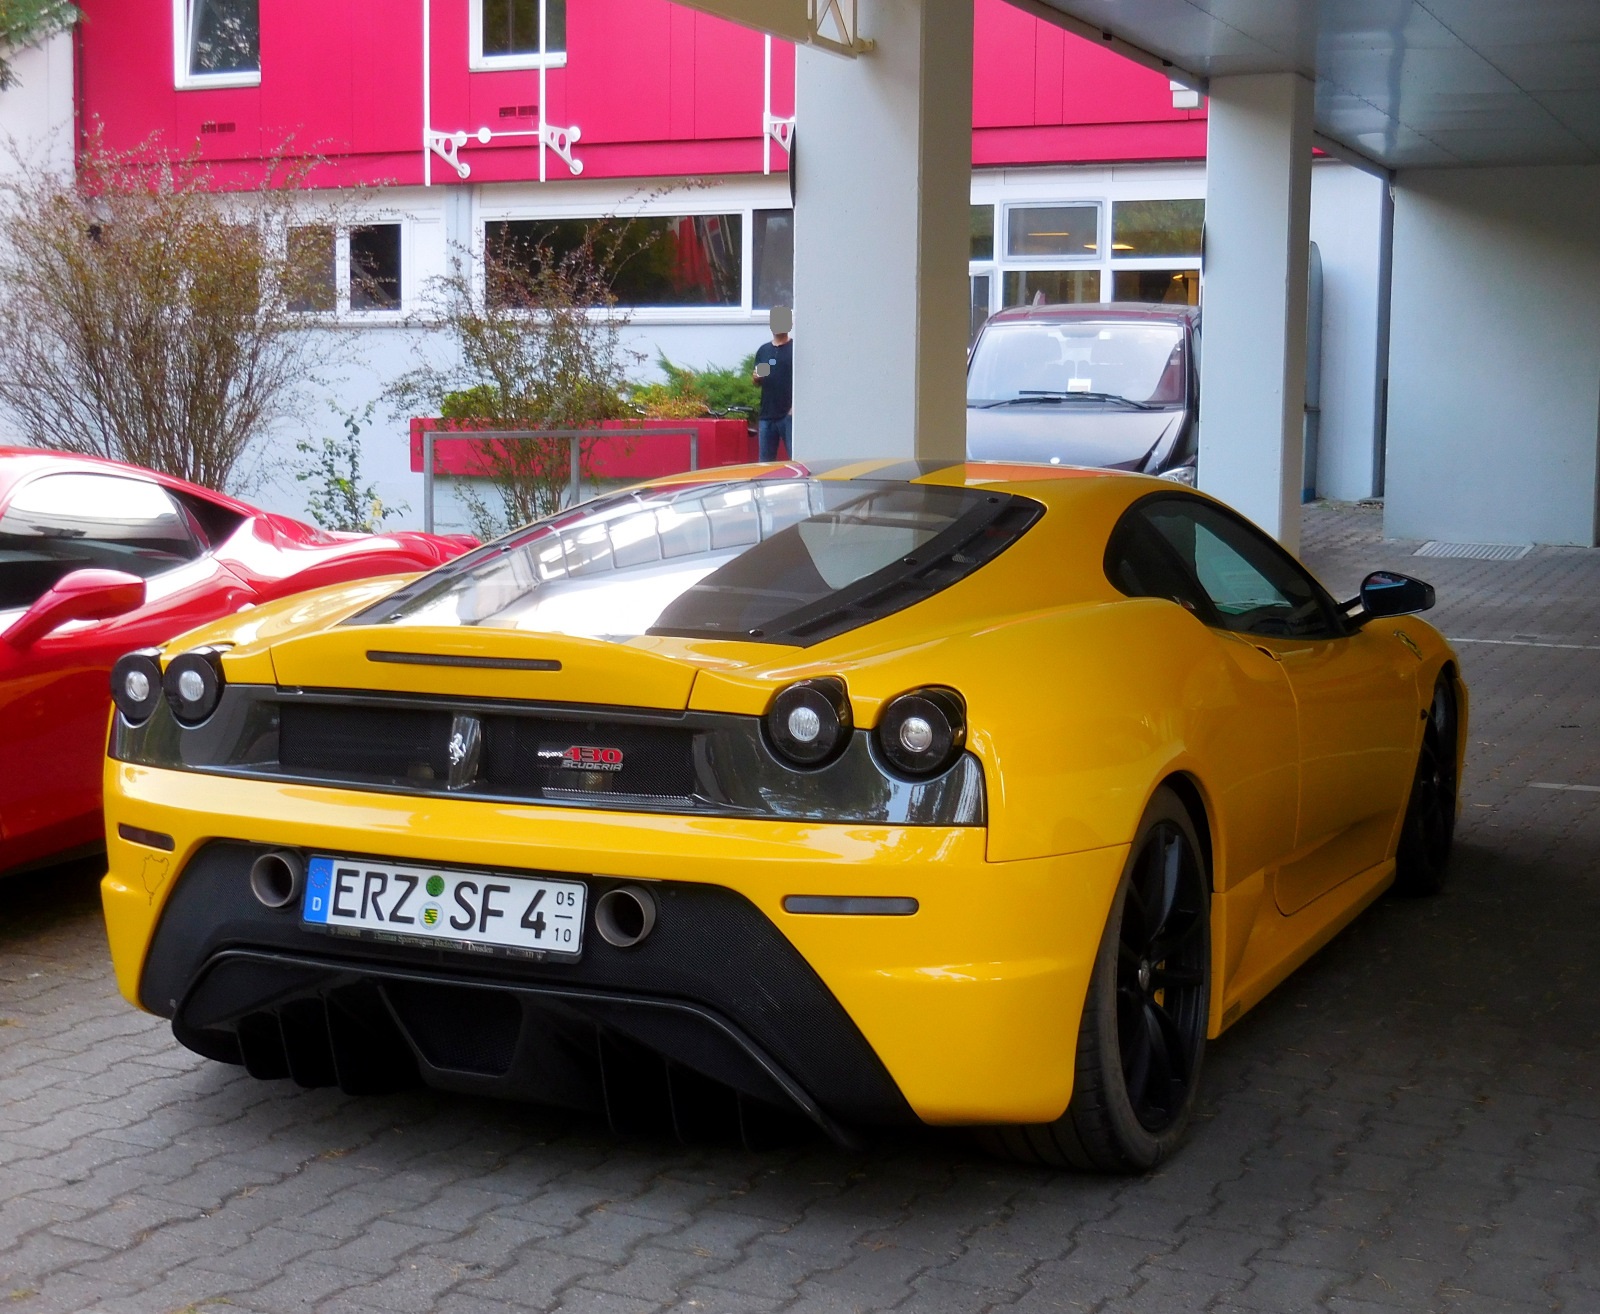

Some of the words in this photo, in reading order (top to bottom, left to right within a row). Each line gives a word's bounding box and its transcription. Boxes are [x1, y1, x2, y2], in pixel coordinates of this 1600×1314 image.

[562, 746, 624, 764] 430
[561, 759, 624, 772] SCUDERIA
[312, 896, 322, 912] D
[332, 868, 419, 924] ERZ
[449, 880, 511, 933] SF
[520, 888, 547, 940] 4
[555, 891, 576, 907] 05
[554, 927, 573, 943] 10
